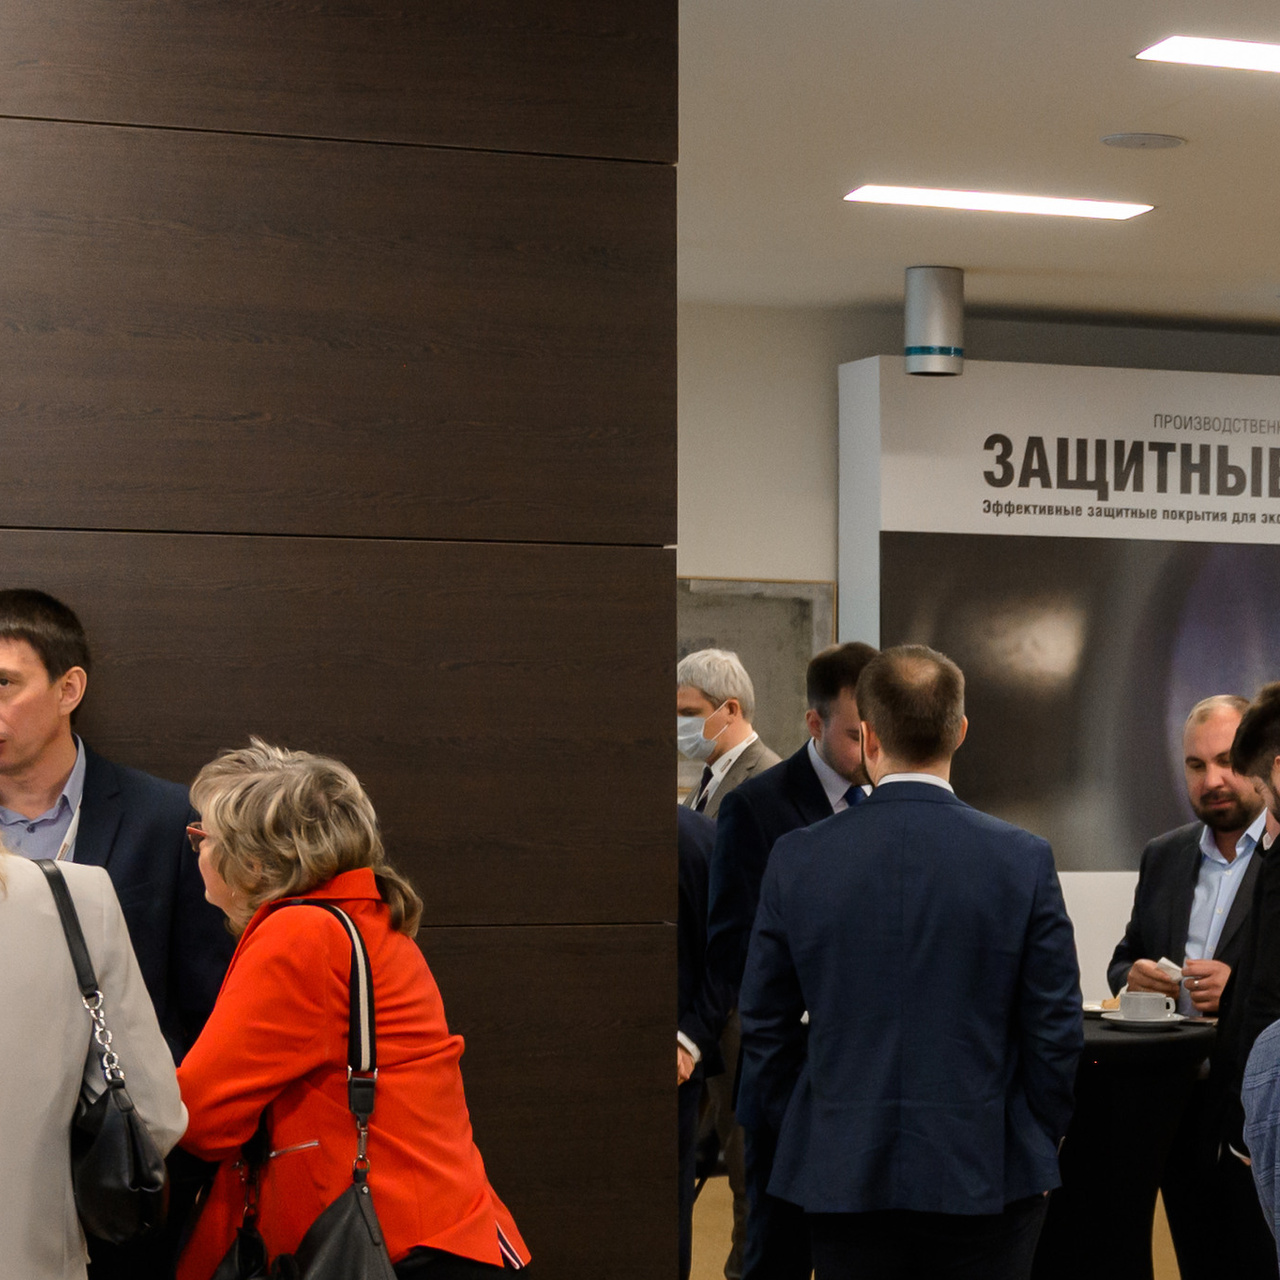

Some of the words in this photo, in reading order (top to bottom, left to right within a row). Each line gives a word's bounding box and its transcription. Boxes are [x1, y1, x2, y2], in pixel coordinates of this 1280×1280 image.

[982, 499, 1082, 517] Эффективные
[1087, 506, 1157, 520] защитные
[1162, 509, 1227, 523] покрытия
[1231, 512, 1256, 524] для
